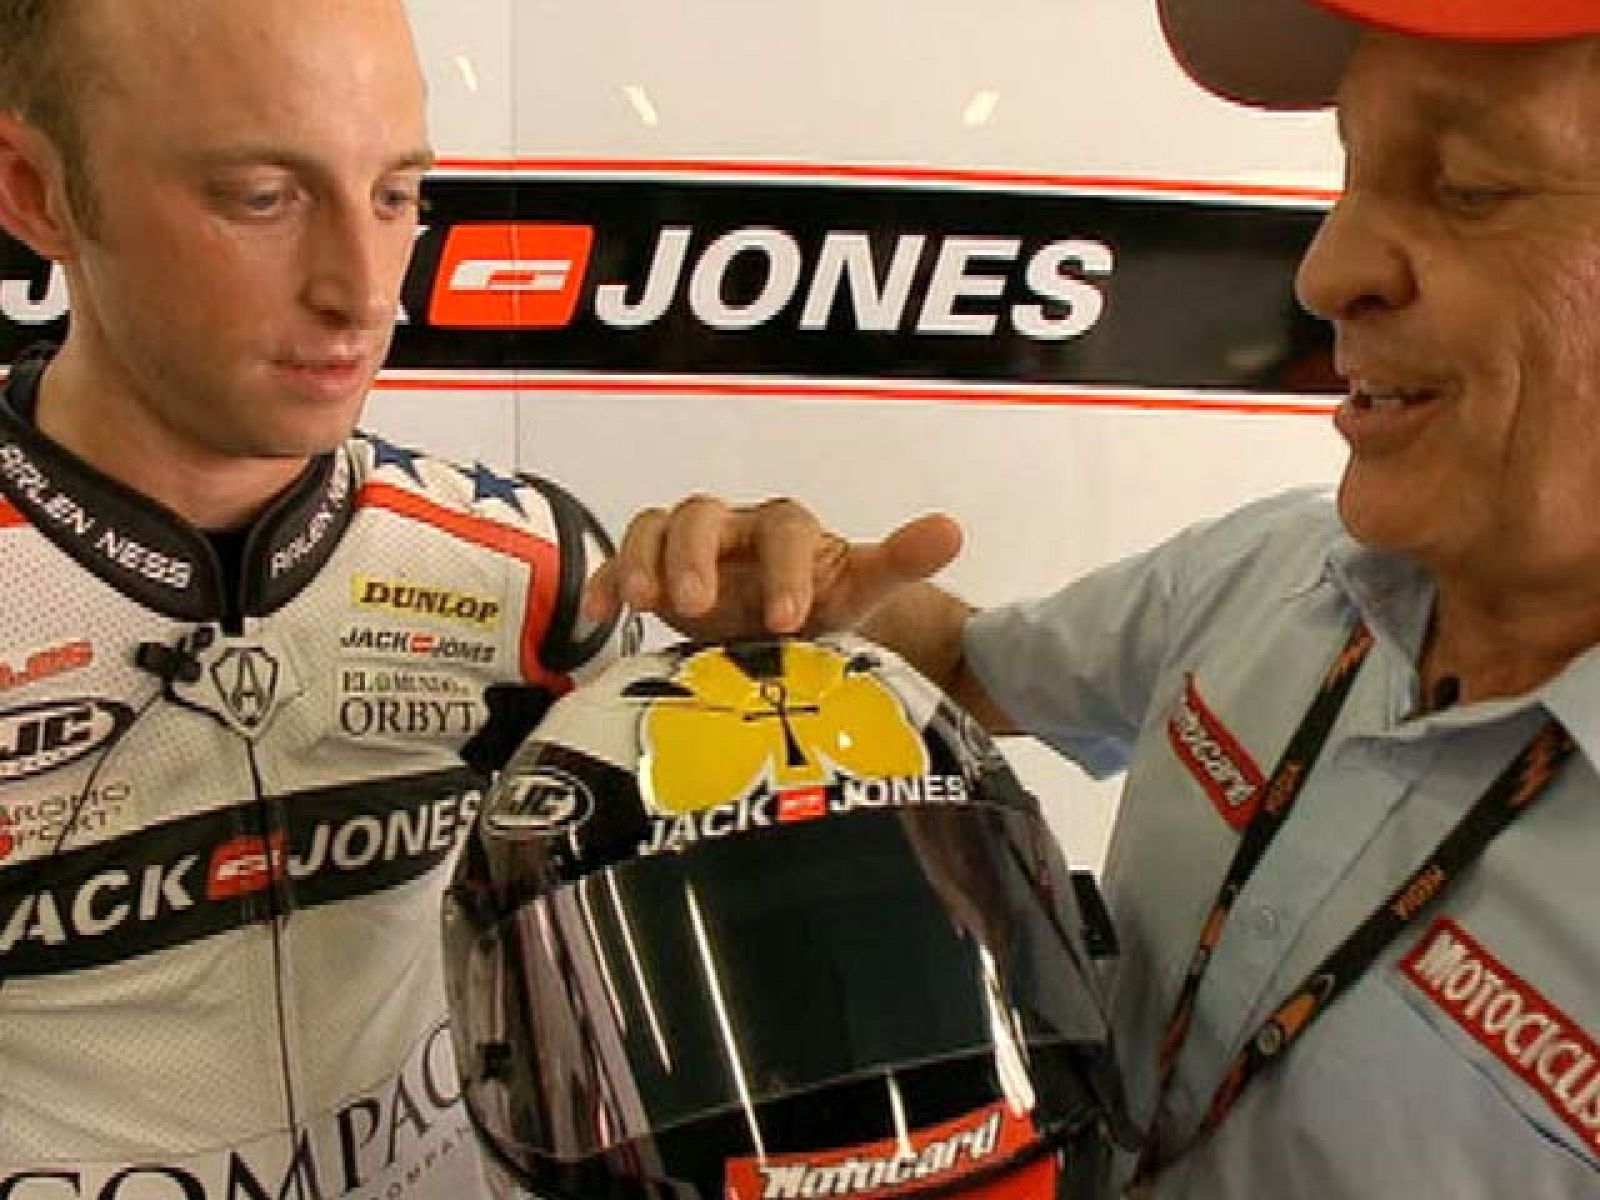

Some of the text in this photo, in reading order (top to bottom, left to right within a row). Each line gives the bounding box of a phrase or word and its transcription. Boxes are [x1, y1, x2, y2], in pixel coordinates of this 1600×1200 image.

[595, 225, 1114, 340] JONES
[95, 528, 191, 588] NESS
[360, 581, 499, 622] DUNLOP
[339, 697, 476, 736] ORBYT
[285, 787, 482, 878] JONES
[637, 772, 968, 857] JACK JONES
[760, 1112, 1000, 1200] Motocard
